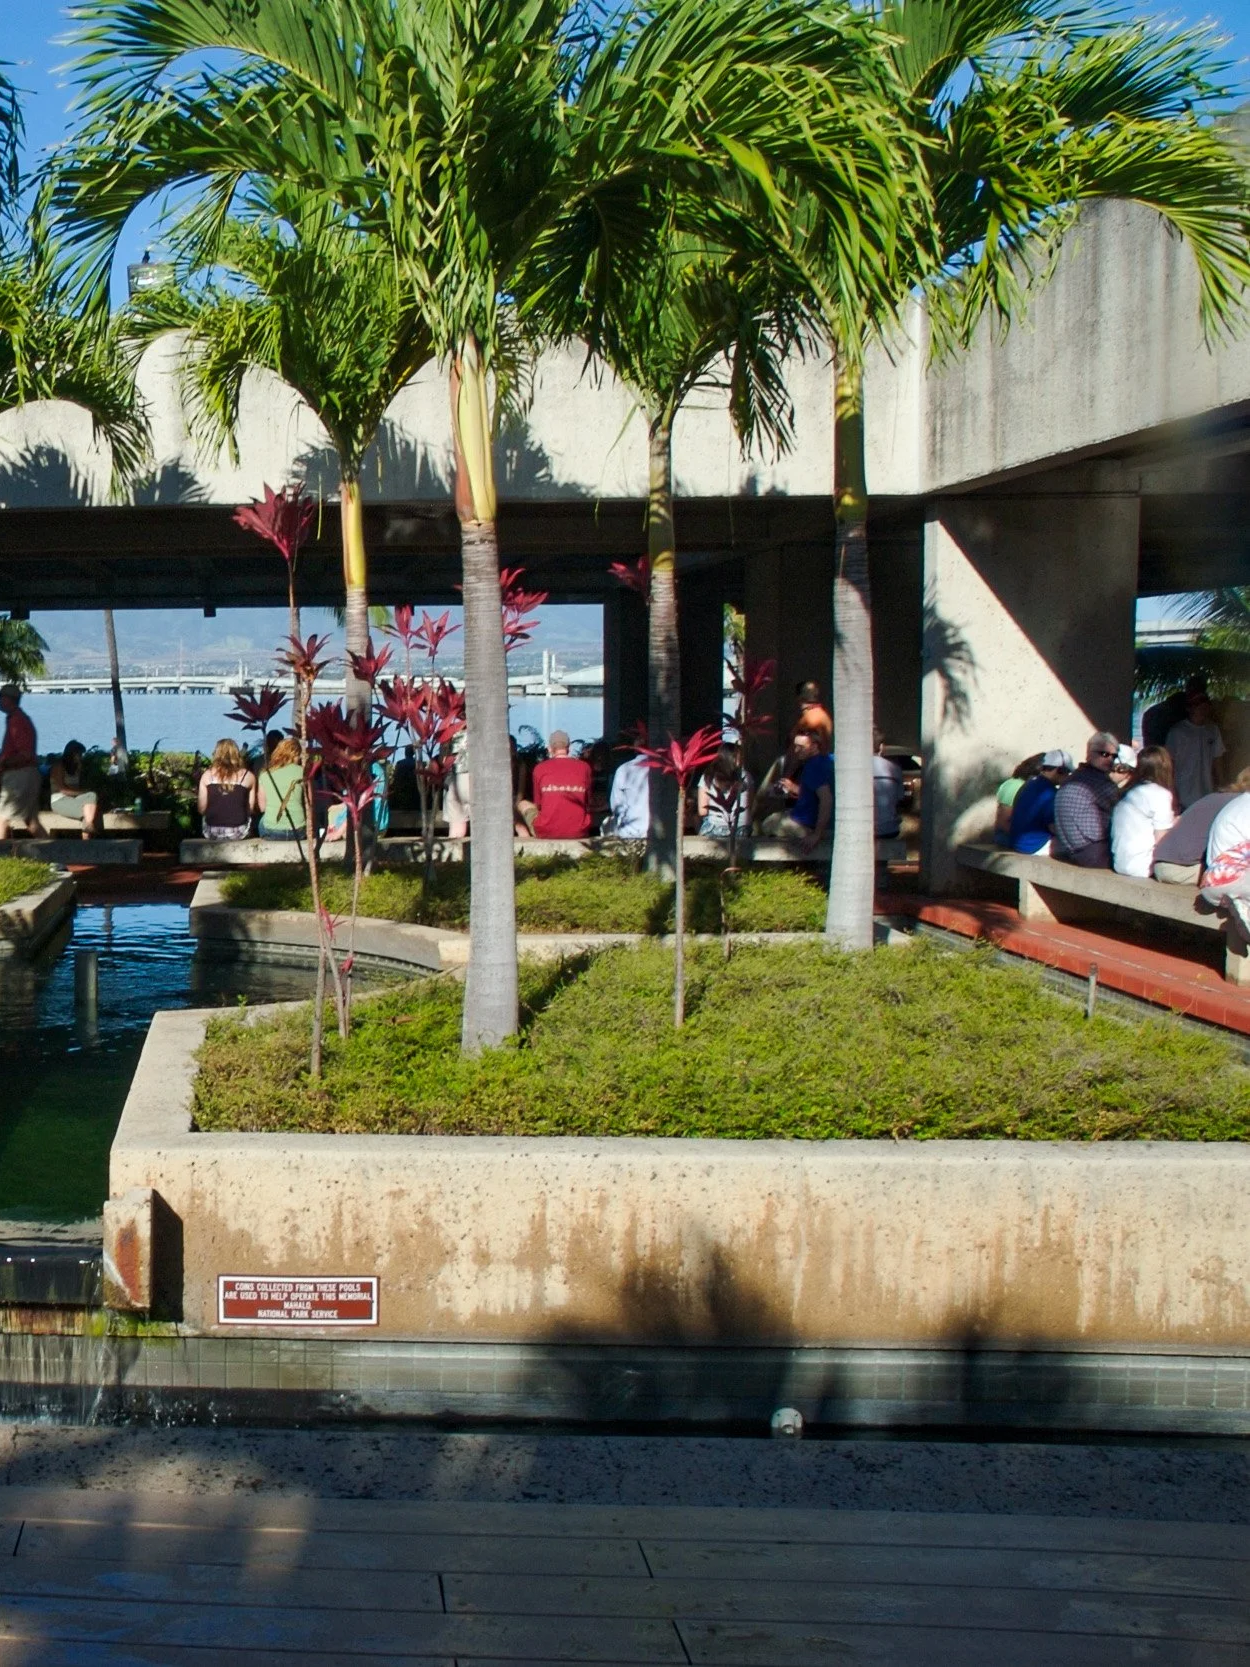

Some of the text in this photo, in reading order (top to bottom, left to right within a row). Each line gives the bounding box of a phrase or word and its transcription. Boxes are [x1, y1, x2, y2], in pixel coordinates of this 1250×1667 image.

[257, 1282, 293, 1291] COLLECTED
[295, 1283, 314, 1292] FROM
[317, 1283, 336, 1292] THESE
[339, 1283, 361, 1292] POOLS
[224, 1291, 237, 1300] ARE
[240, 1291, 258, 1300] USED
[260, 1292, 268, 1300] TO
[271, 1292, 288, 1300] HELP
[290, 1292, 319, 1301] OPERATE
[322, 1292, 336, 1301] THIS
[257, 1309, 338, 1318] NATIONAL PARK SERVICE
